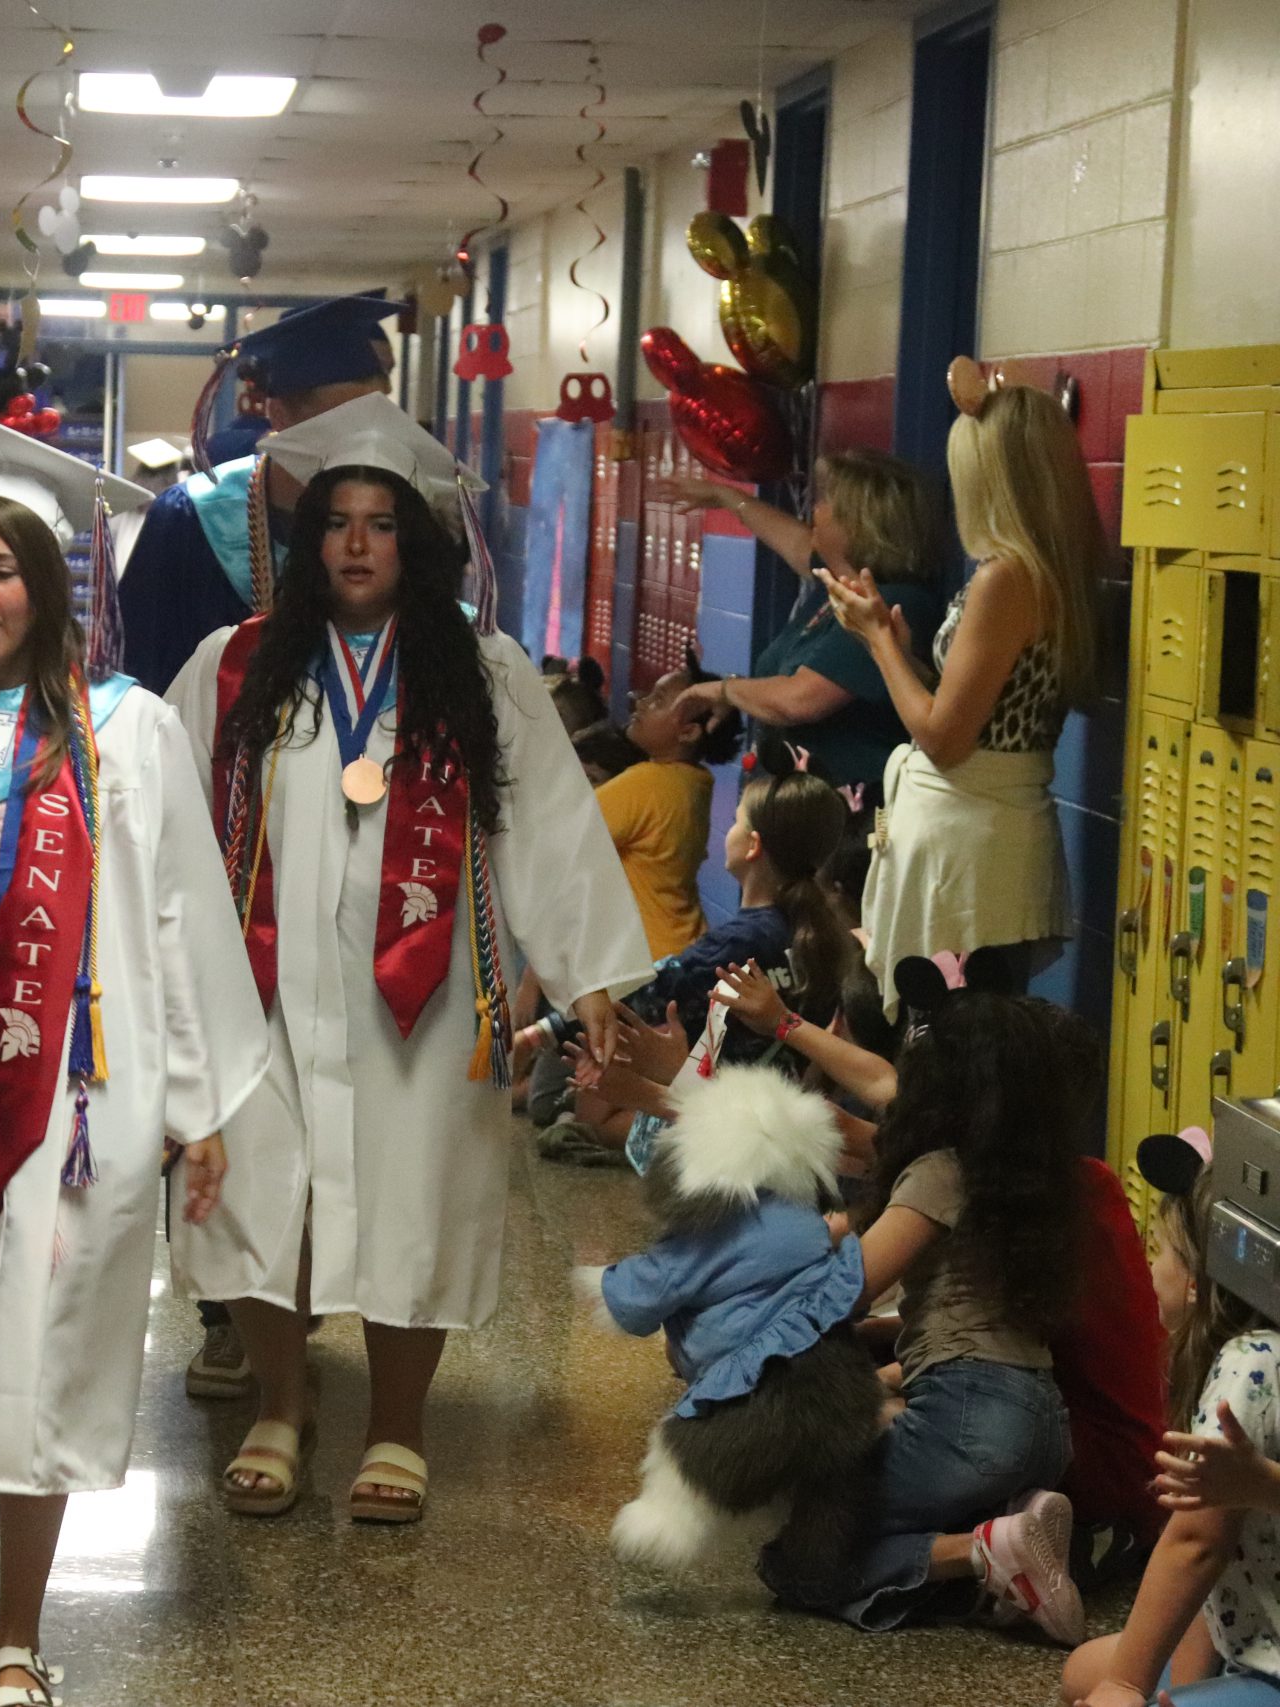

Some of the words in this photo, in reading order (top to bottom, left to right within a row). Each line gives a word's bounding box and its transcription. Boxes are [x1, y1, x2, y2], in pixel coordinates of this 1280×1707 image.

[111, 293, 147, 322] EXIT
[410, 760, 451, 880] NATE
[13, 793, 70, 1005] SENATE
